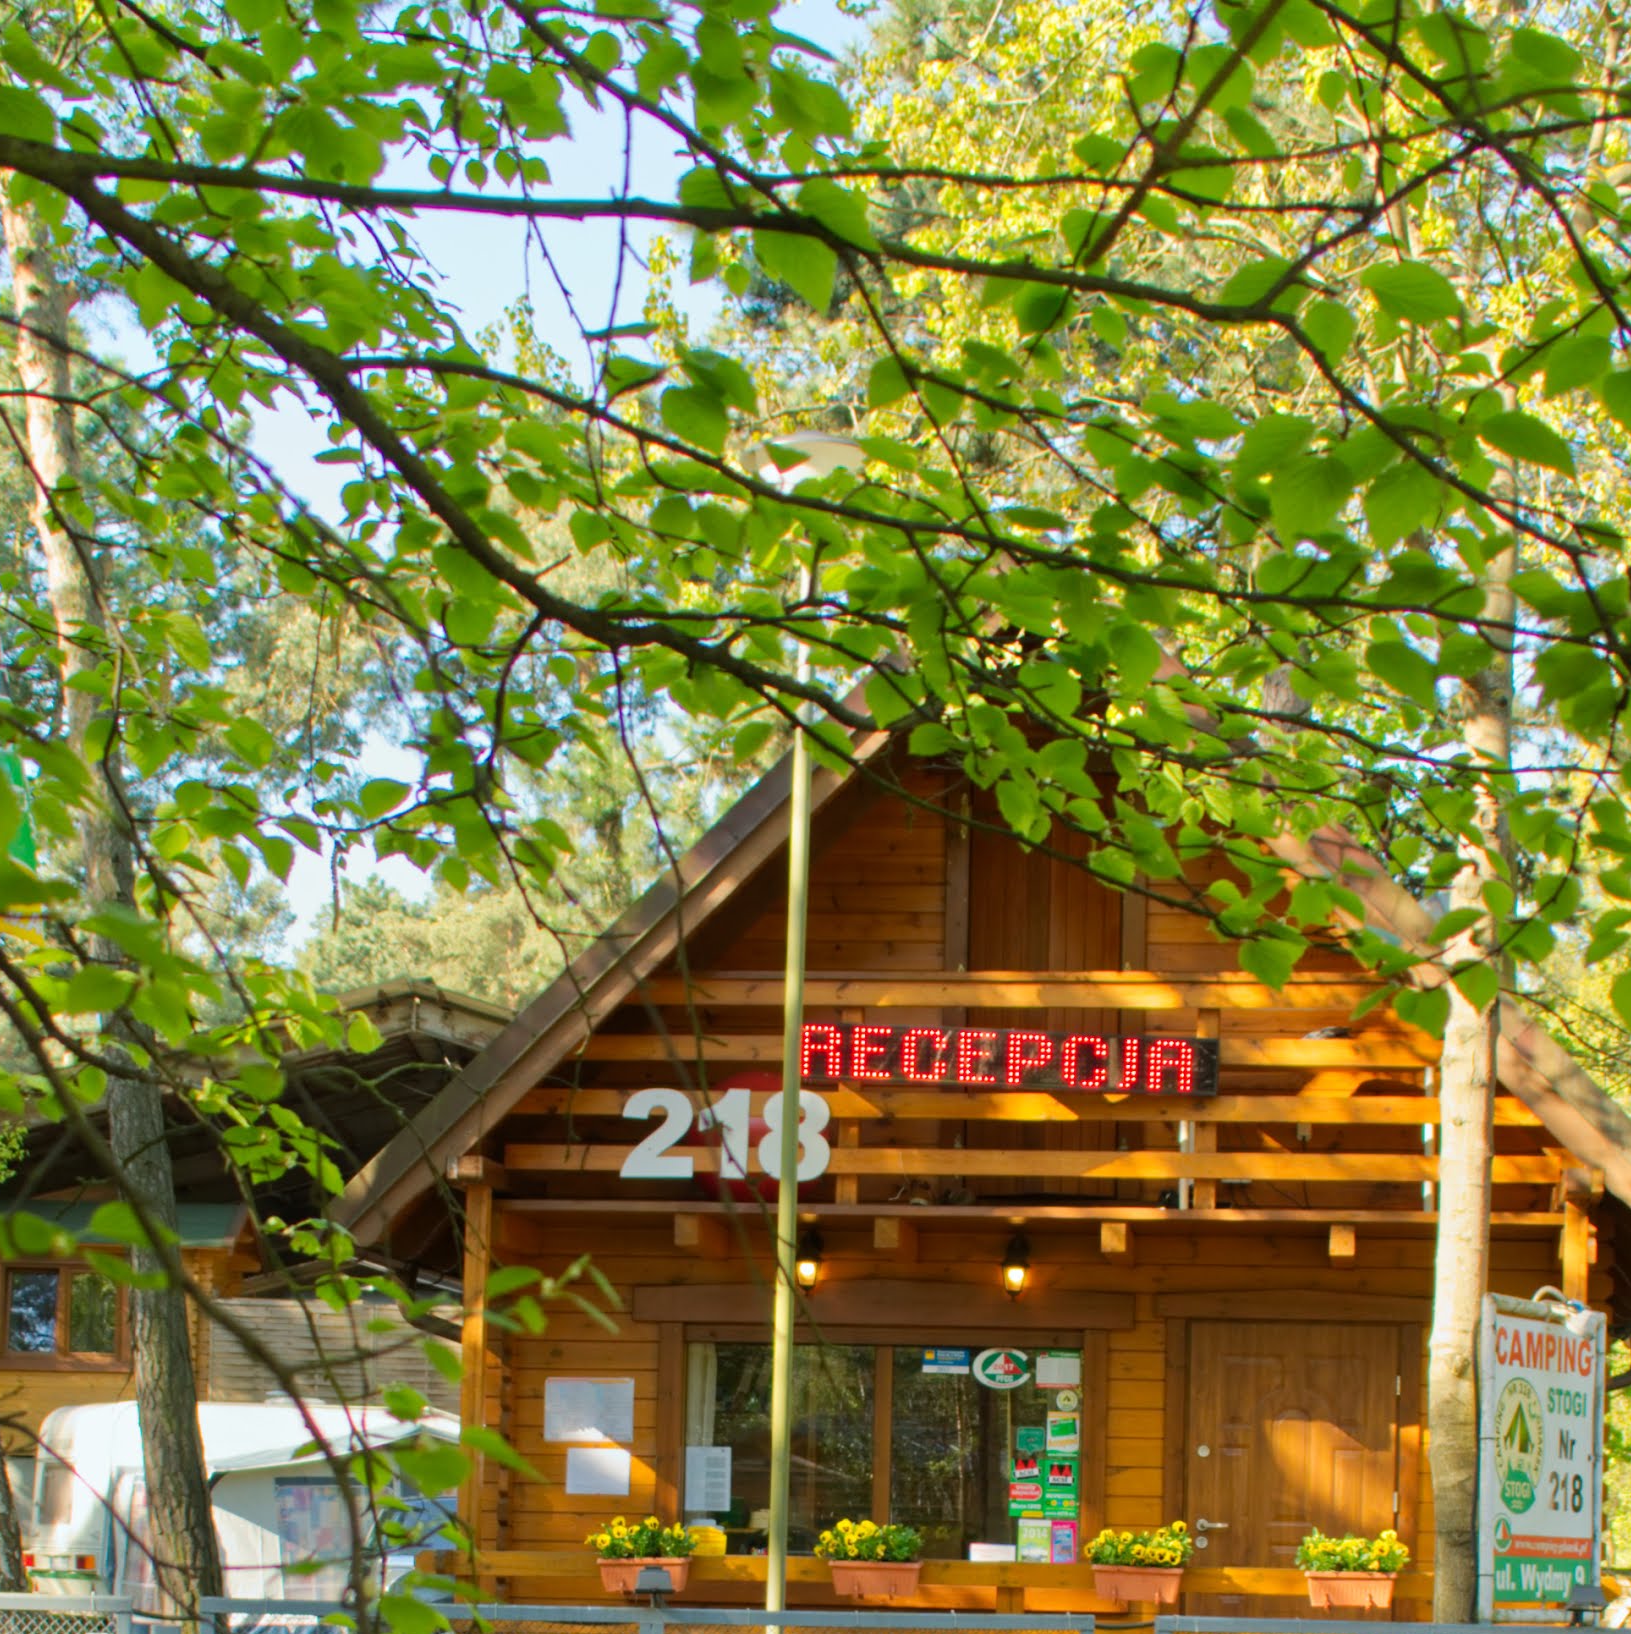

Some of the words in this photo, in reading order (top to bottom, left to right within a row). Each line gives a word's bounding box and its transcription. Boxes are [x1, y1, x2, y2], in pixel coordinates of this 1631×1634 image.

[801, 1024, 1194, 1092] RECEPCJA
[620, 1088, 832, 1181] 218
[1496, 1326, 1592, 1377] CAMPING
[1548, 1387, 1587, 1417] STOGI
[1559, 1428, 1576, 1460] Nr
[1504, 1480, 1532, 1498] STOGI
[1549, 1471, 1583, 1513] 218
[1495, 1563, 1516, 1590] ul.
[1520, 1564, 1572, 1598] Wydmy
[1575, 1565, 1585, 1585] 9
